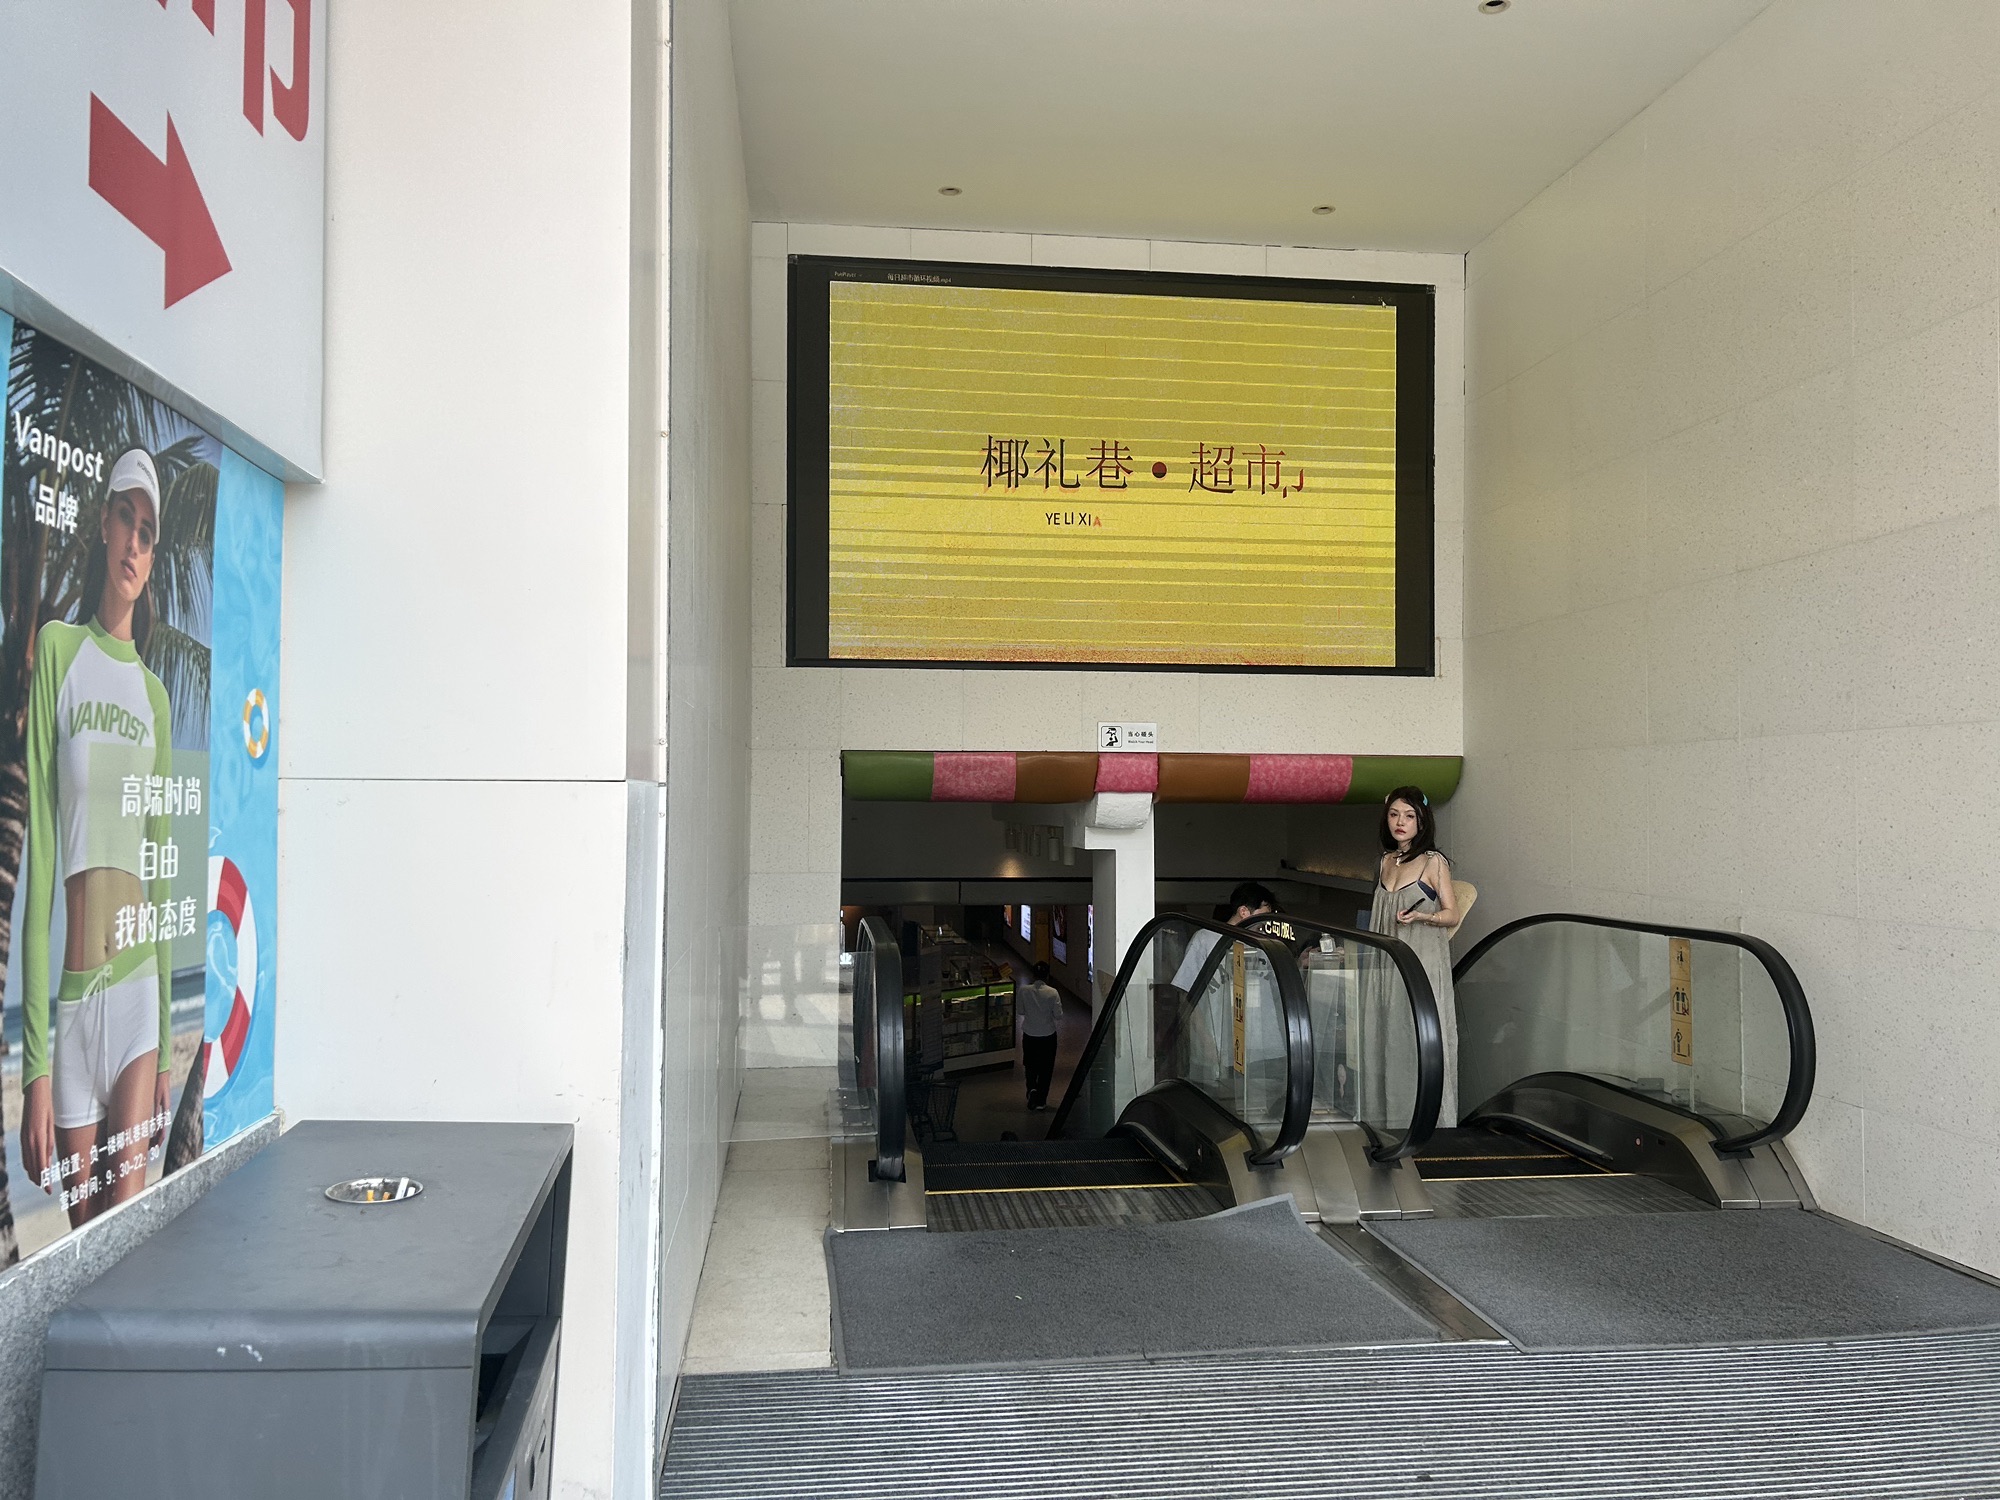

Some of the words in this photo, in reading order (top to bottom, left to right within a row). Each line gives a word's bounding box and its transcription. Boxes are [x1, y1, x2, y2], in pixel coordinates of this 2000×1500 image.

[15, 412, 104, 482] Vanpost
[35, 484, 78, 534] 品牌
[69, 701, 149, 745] VANPOST
[121, 774, 202, 817] 高端时尚
[139, 837, 179, 881] 自由
[115, 896, 197, 949] 我的态度
